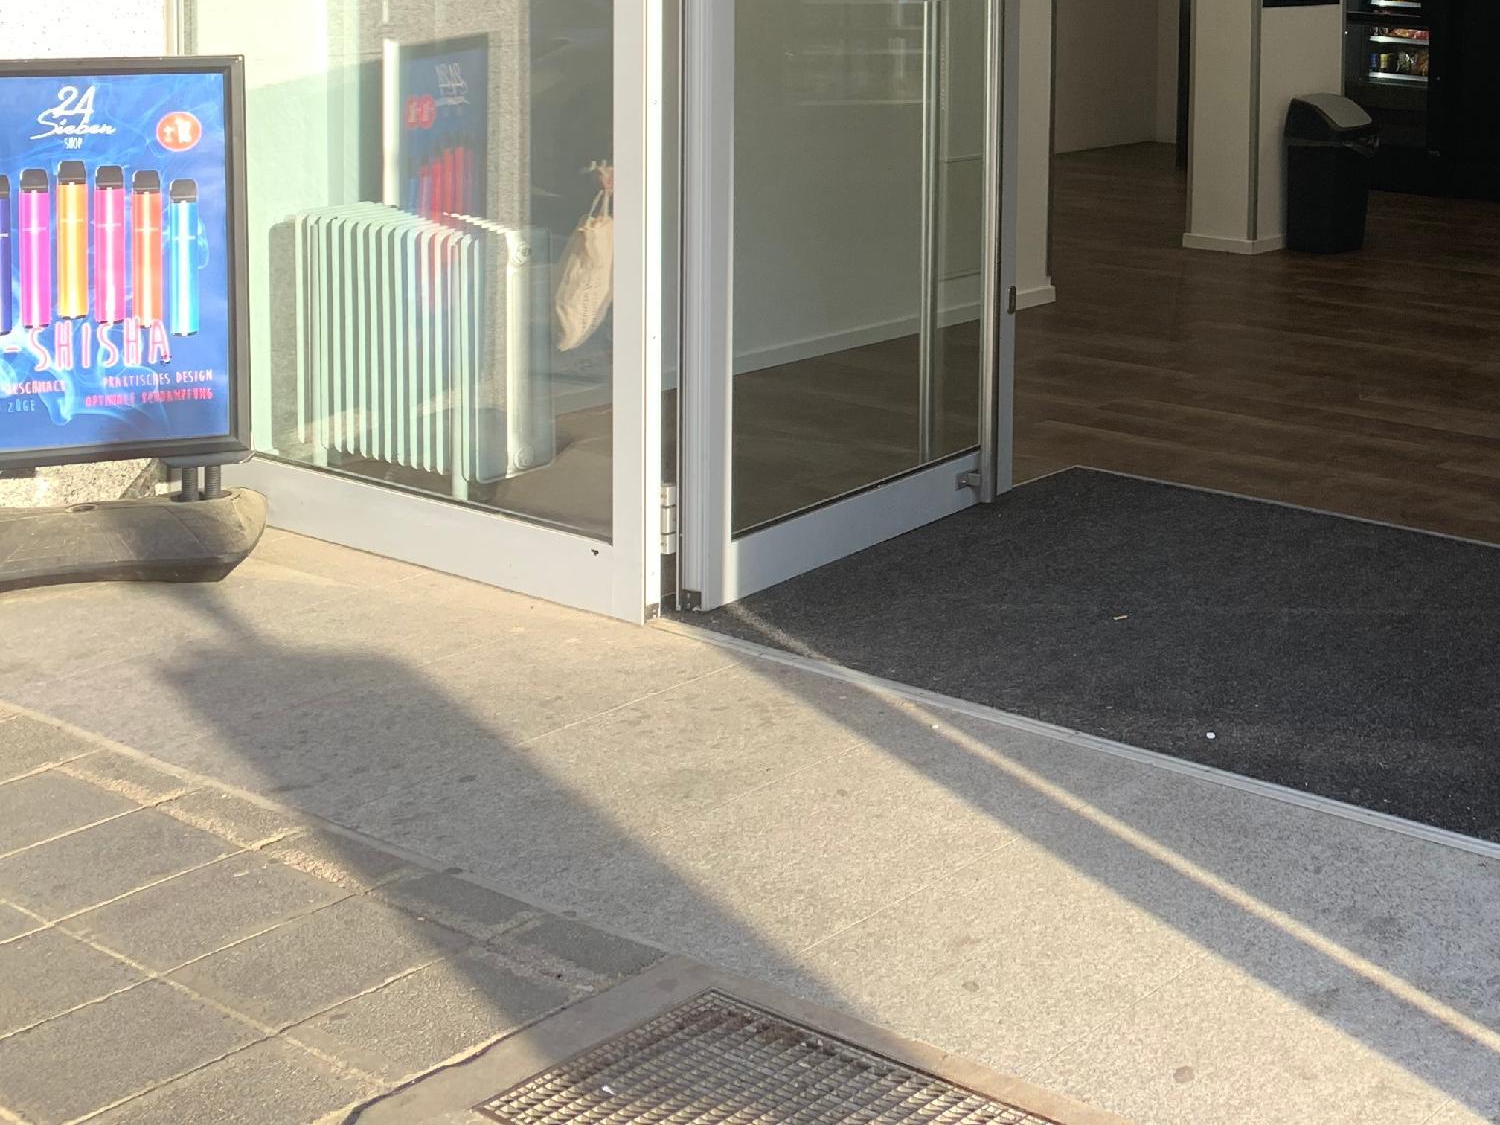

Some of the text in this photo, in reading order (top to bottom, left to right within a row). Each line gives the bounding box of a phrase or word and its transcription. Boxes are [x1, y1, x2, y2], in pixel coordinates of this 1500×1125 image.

[54, 85, 96, 125] 24
[30, 108, 117, 140] Sieben
[176, 369, 213, 384] DESIGN
